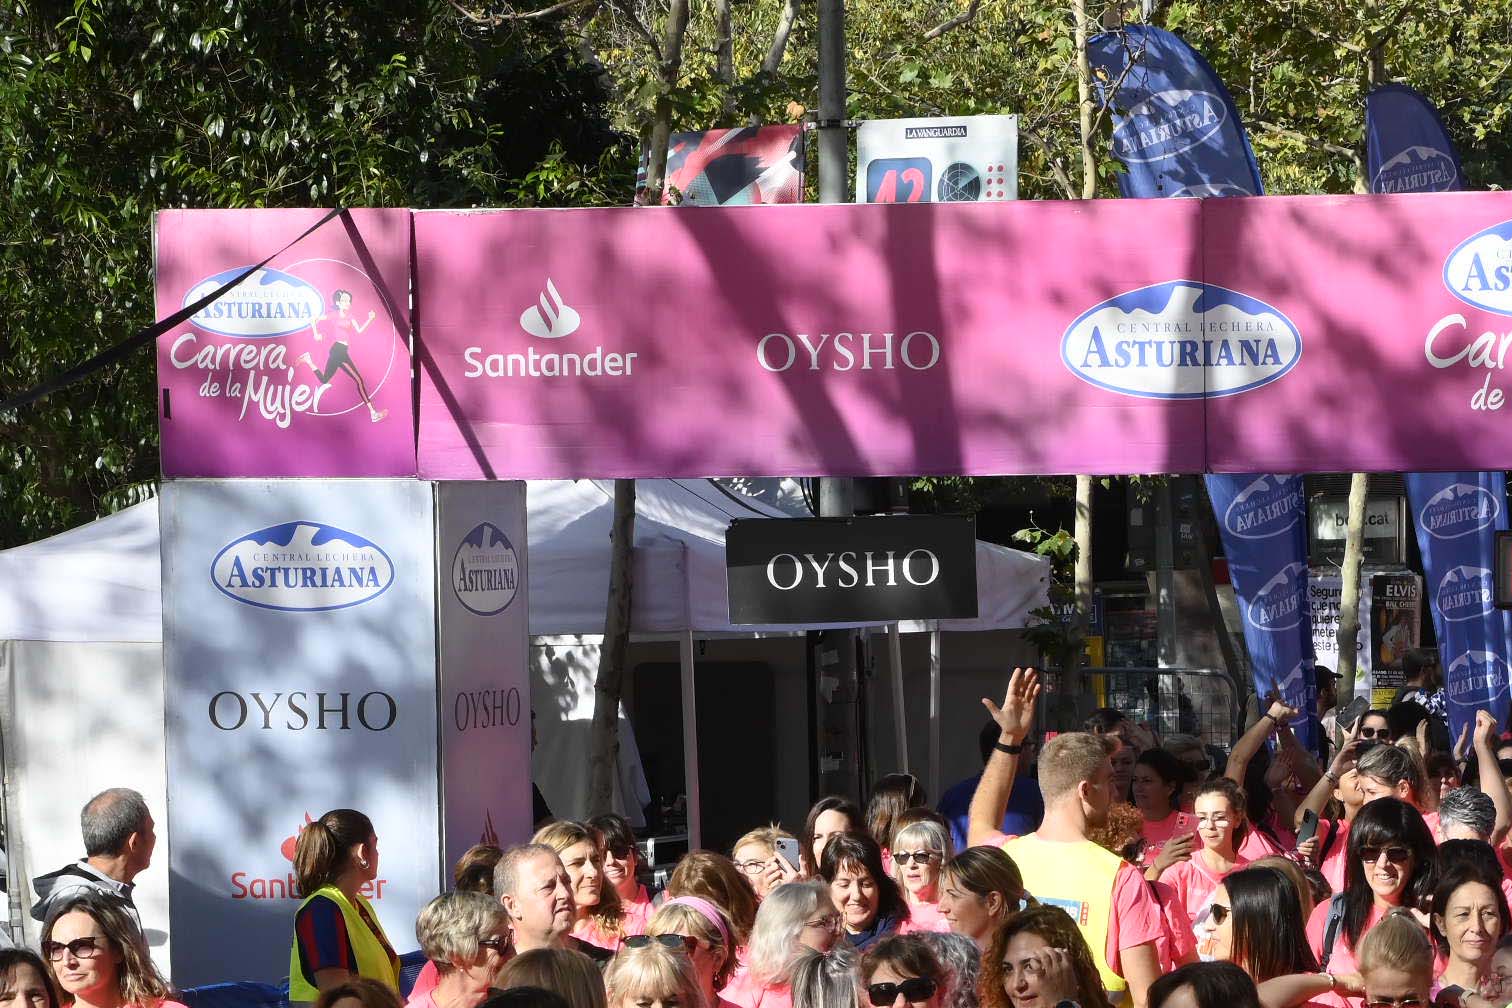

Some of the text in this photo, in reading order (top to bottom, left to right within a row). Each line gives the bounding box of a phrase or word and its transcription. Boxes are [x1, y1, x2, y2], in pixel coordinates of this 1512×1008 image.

[1117, 321, 1275, 333] CENTRAL LECHERA
[170, 333, 288, 369] Carrera
[464, 346, 638, 377] Santander
[756, 331, 941, 373] OYSHO
[1080, 326, 1284, 368] ASTURIANA
[200, 367, 332, 429] de la Mujer
[1471, 372, 1504, 411] de
[225, 556, 382, 588] ASTURIANA
[253, 552, 311, 562] CENTRAL
[457, 557, 516, 593] ASTURIANA
[767, 549, 940, 590] OYSHO
[1386, 585, 1416, 597] ELVIS
[1312, 614, 1344, 626] quiere
[1312, 627, 1337, 638] mete
[208, 690, 398, 732] OYSHO
[454, 687, 522, 732] OYSHO
[231, 872, 387, 900] Santer
